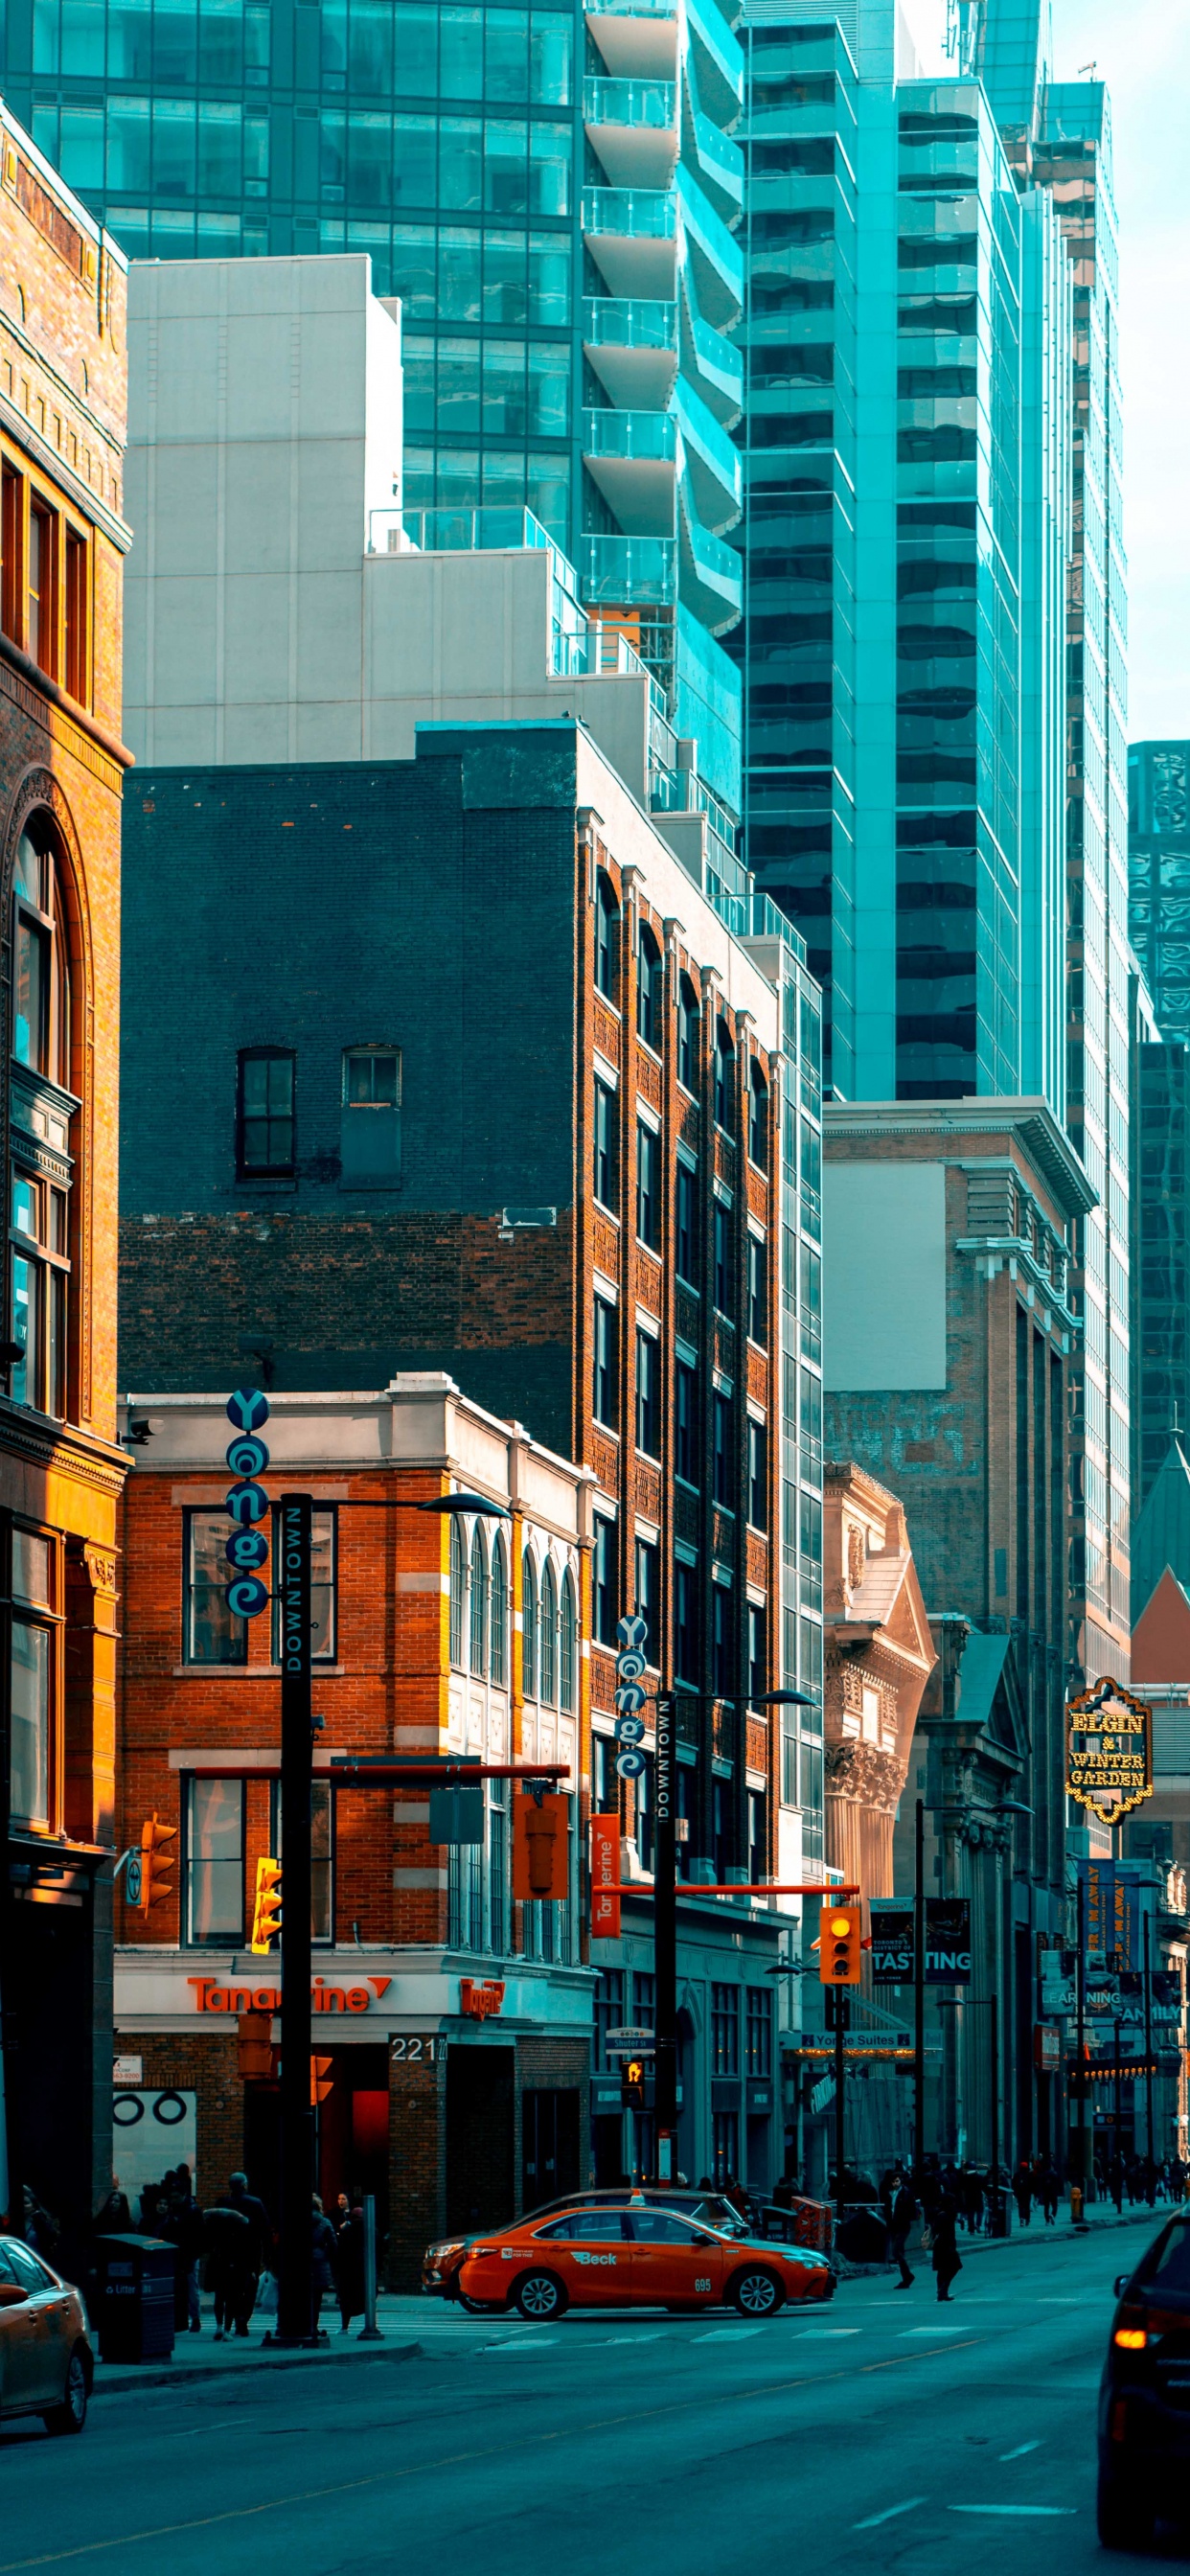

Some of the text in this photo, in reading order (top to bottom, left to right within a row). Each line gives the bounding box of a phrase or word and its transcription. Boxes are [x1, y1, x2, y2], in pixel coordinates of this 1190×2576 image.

[226, 1389, 265, 1617] Yonge
[287, 1507, 301, 1670] DOWNTOWN
[615, 1616, 645, 1780] Yonge
[1070, 1713, 1144, 1733] ELGIN
[1102, 1736, 1115, 1750] &
[658, 1700, 670, 1817] DOWNTOWN
[1071, 1753, 1144, 1768] WINTER
[1071, 1771, 1144, 1786] GARDEN
[1088, 1866, 1099, 1906] AWAY
[614, 2039, 638, 2048] Shuter
[858, 2036, 894, 2045] Suites
[391, 2038, 434, 2060] 221
[580, 2252, 616, 2265] Beck
[116, 2285, 135, 2294] Litter
[695, 2279, 711, 2291] 695
